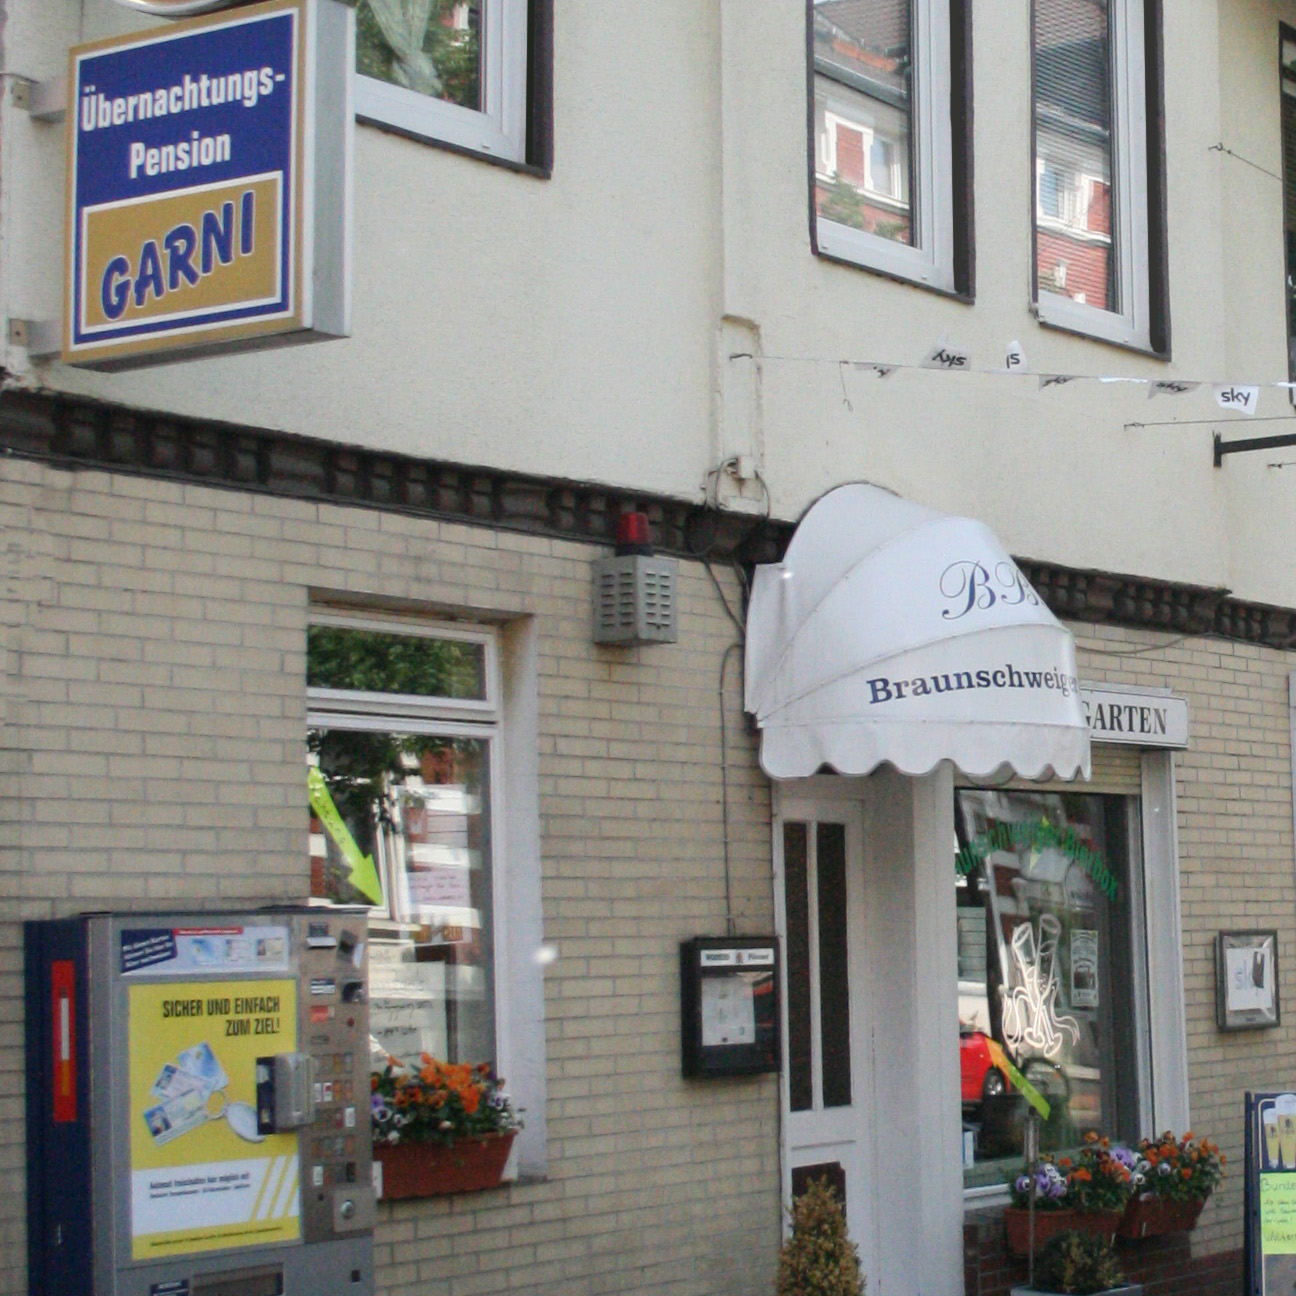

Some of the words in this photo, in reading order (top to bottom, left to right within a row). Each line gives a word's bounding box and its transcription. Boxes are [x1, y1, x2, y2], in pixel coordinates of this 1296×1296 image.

[81, 66, 285, 131] Übernachtungs-
[129, 131, 231, 179] Pension
[101, 190, 255, 321] GARNI
[1221, 387, 1250, 406] sky
[163, 999, 203, 1018] SICHER
[207, 998, 230, 1016] UND
[234, 996, 280, 1014] EINFACH
[226, 1019, 250, 1037] ZUM
[254, 1017, 280, 1034] ZIEL!
